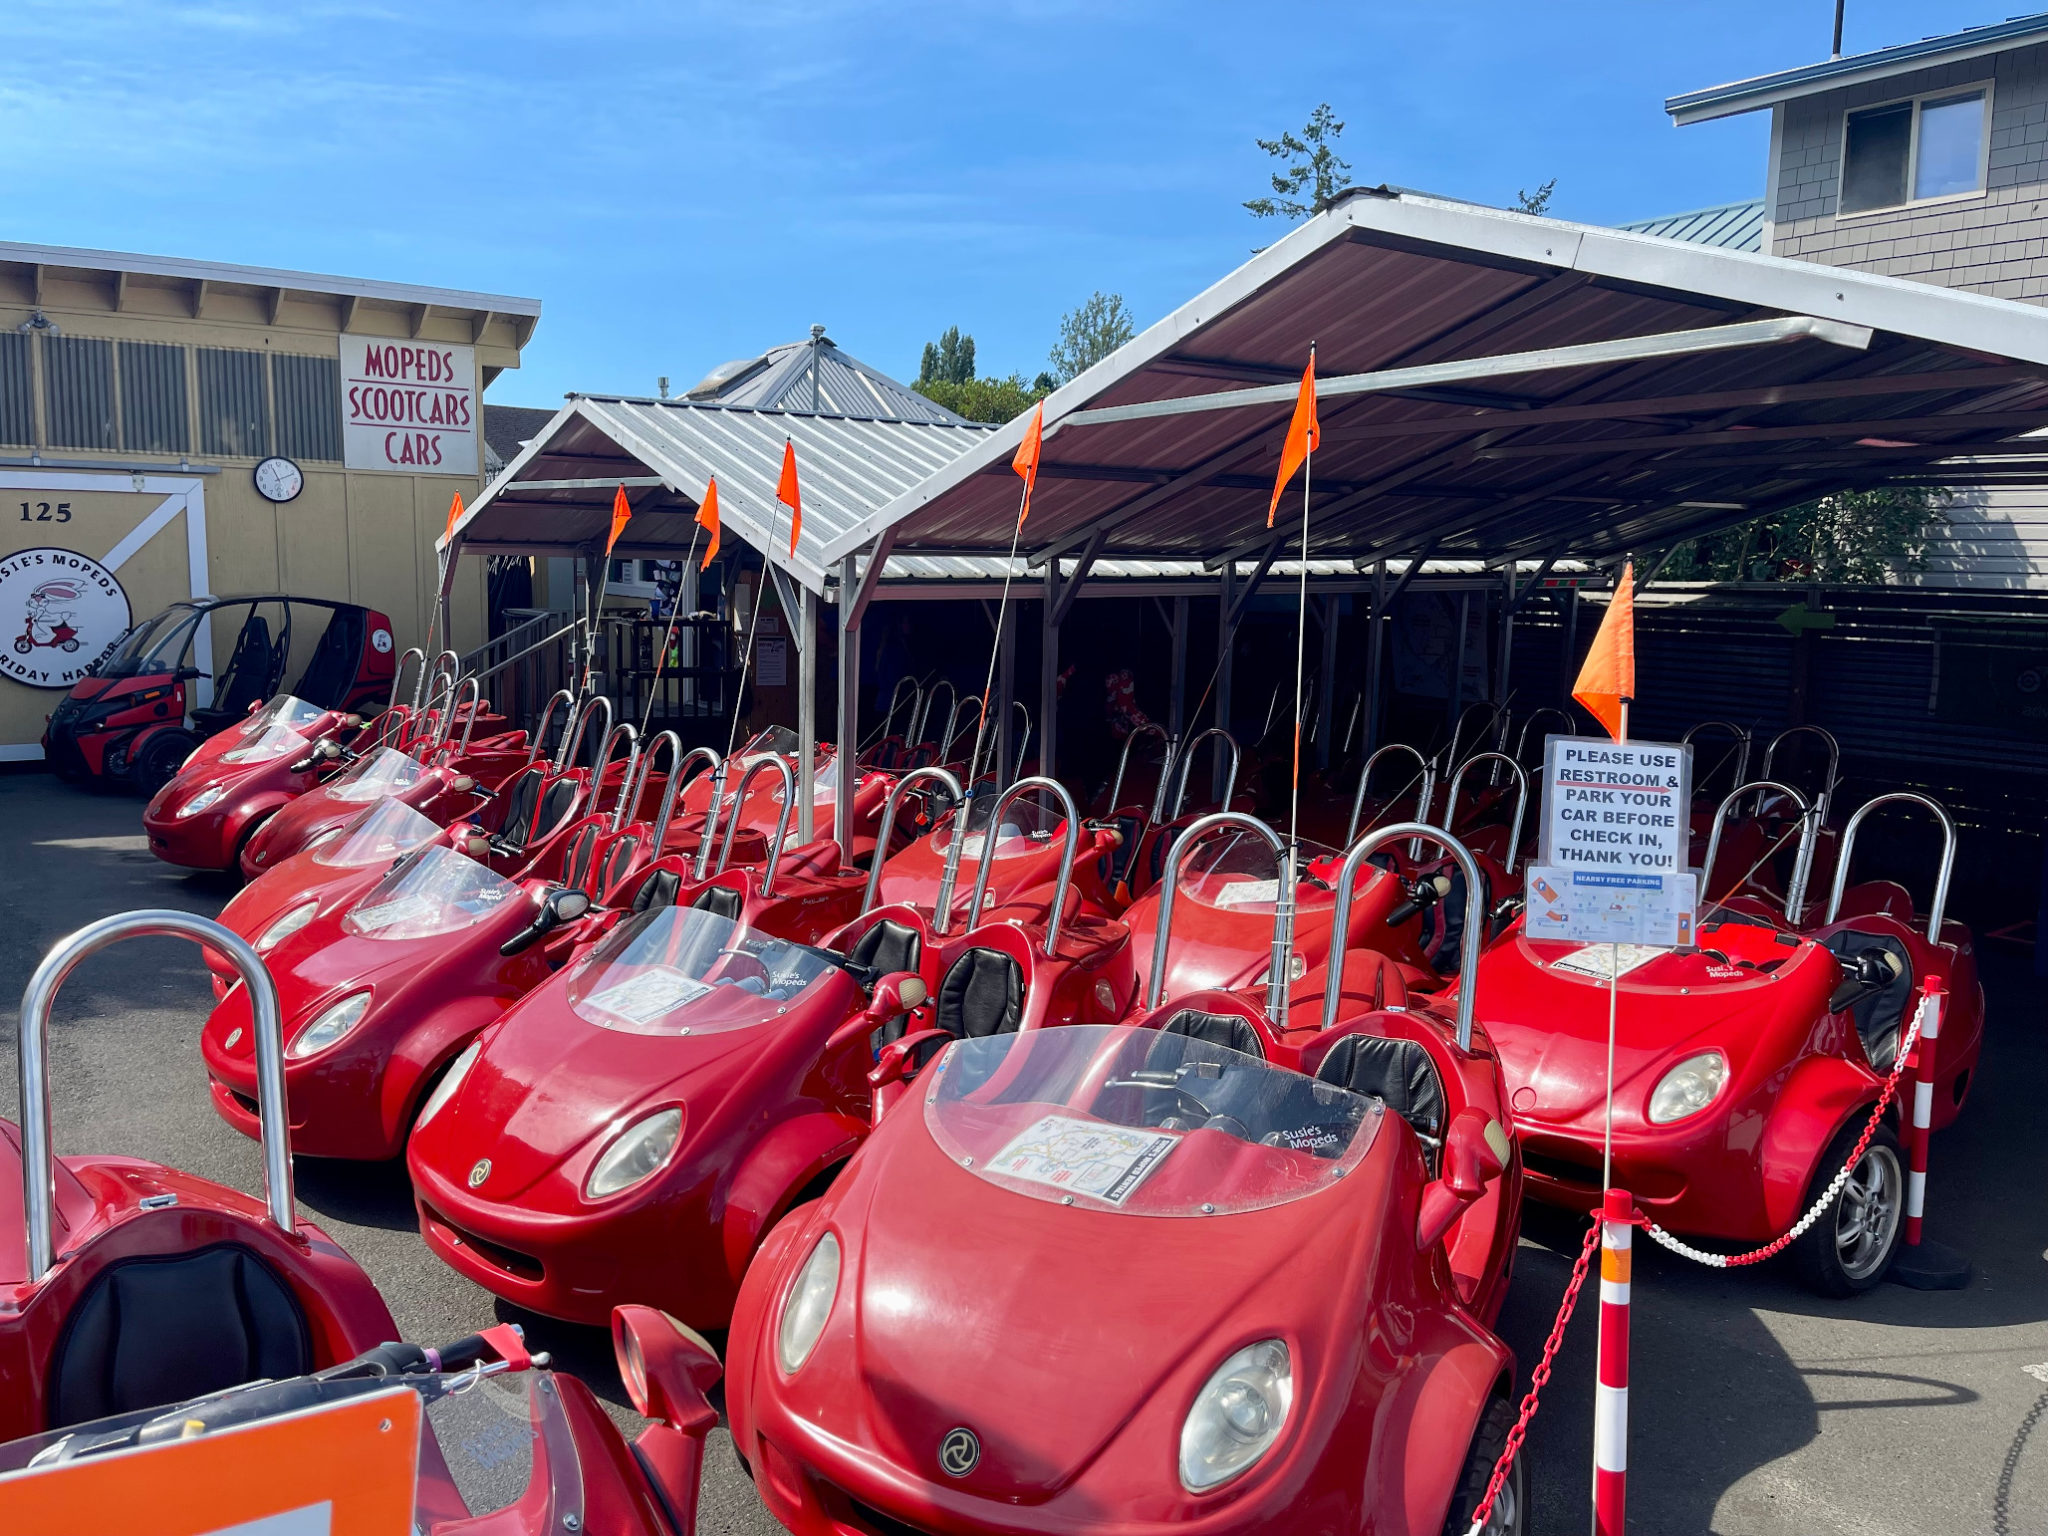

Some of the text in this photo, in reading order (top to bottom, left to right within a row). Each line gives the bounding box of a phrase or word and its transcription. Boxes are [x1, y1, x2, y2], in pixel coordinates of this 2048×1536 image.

[364, 343, 454, 383] MOPEDS
[349, 386, 471, 426] SCOOTCARS
[384, 431, 442, 466] CARS
[20, 502, 72, 523] 125
[0, 554, 117, 597] SIE'S MOPEDS
[0, 651, 50, 682] RIDAY
[1566, 749, 1677, 768] PLEASE USE
[1560, 768, 1679, 788] RESTROOM &
[1566, 788, 1672, 808] PARK YOUR
[1561, 808, 1675, 828] CAR BEFORE
[1570, 829, 1663, 850] CHECK IN,
[1559, 847, 1673, 868] THANK YOU!
[1282, 1125, 1322, 1140] Susie's
[1290, 1133, 1338, 1149] Mopeds
